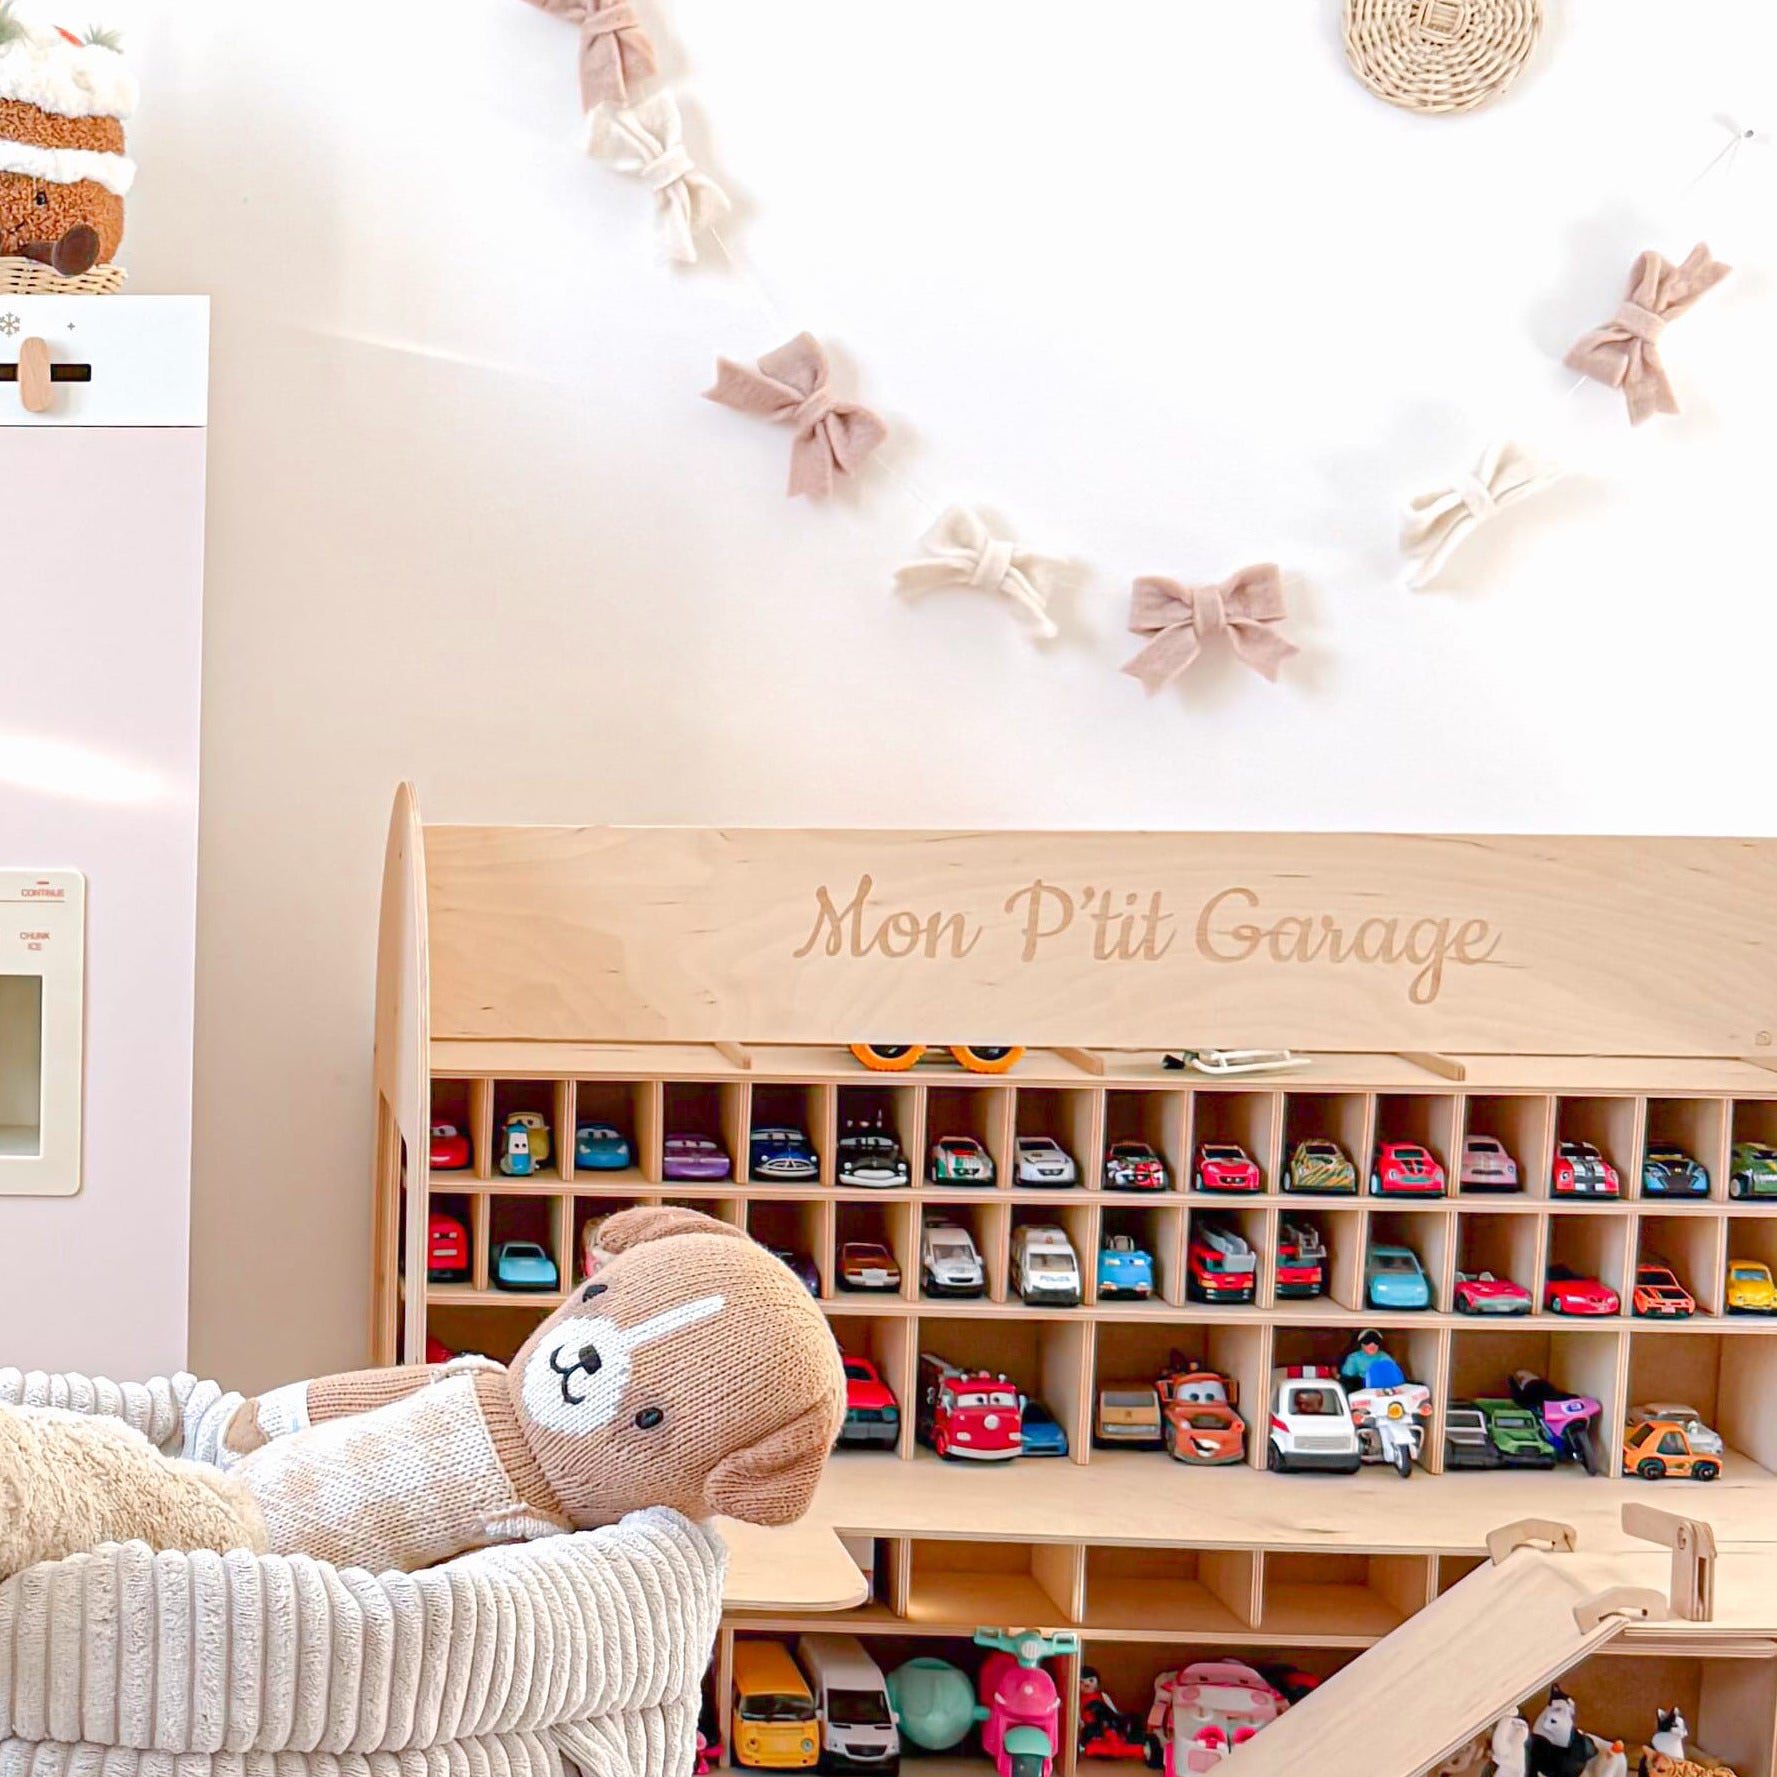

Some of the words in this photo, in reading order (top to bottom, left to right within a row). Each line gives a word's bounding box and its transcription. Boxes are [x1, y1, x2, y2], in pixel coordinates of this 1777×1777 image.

[27, 942, 42, 952] ICE
[792, 874, 984, 959] Mon
[1003, 878, 1177, 963] P'tit
[1194, 887, 1502, 1006] Garage
